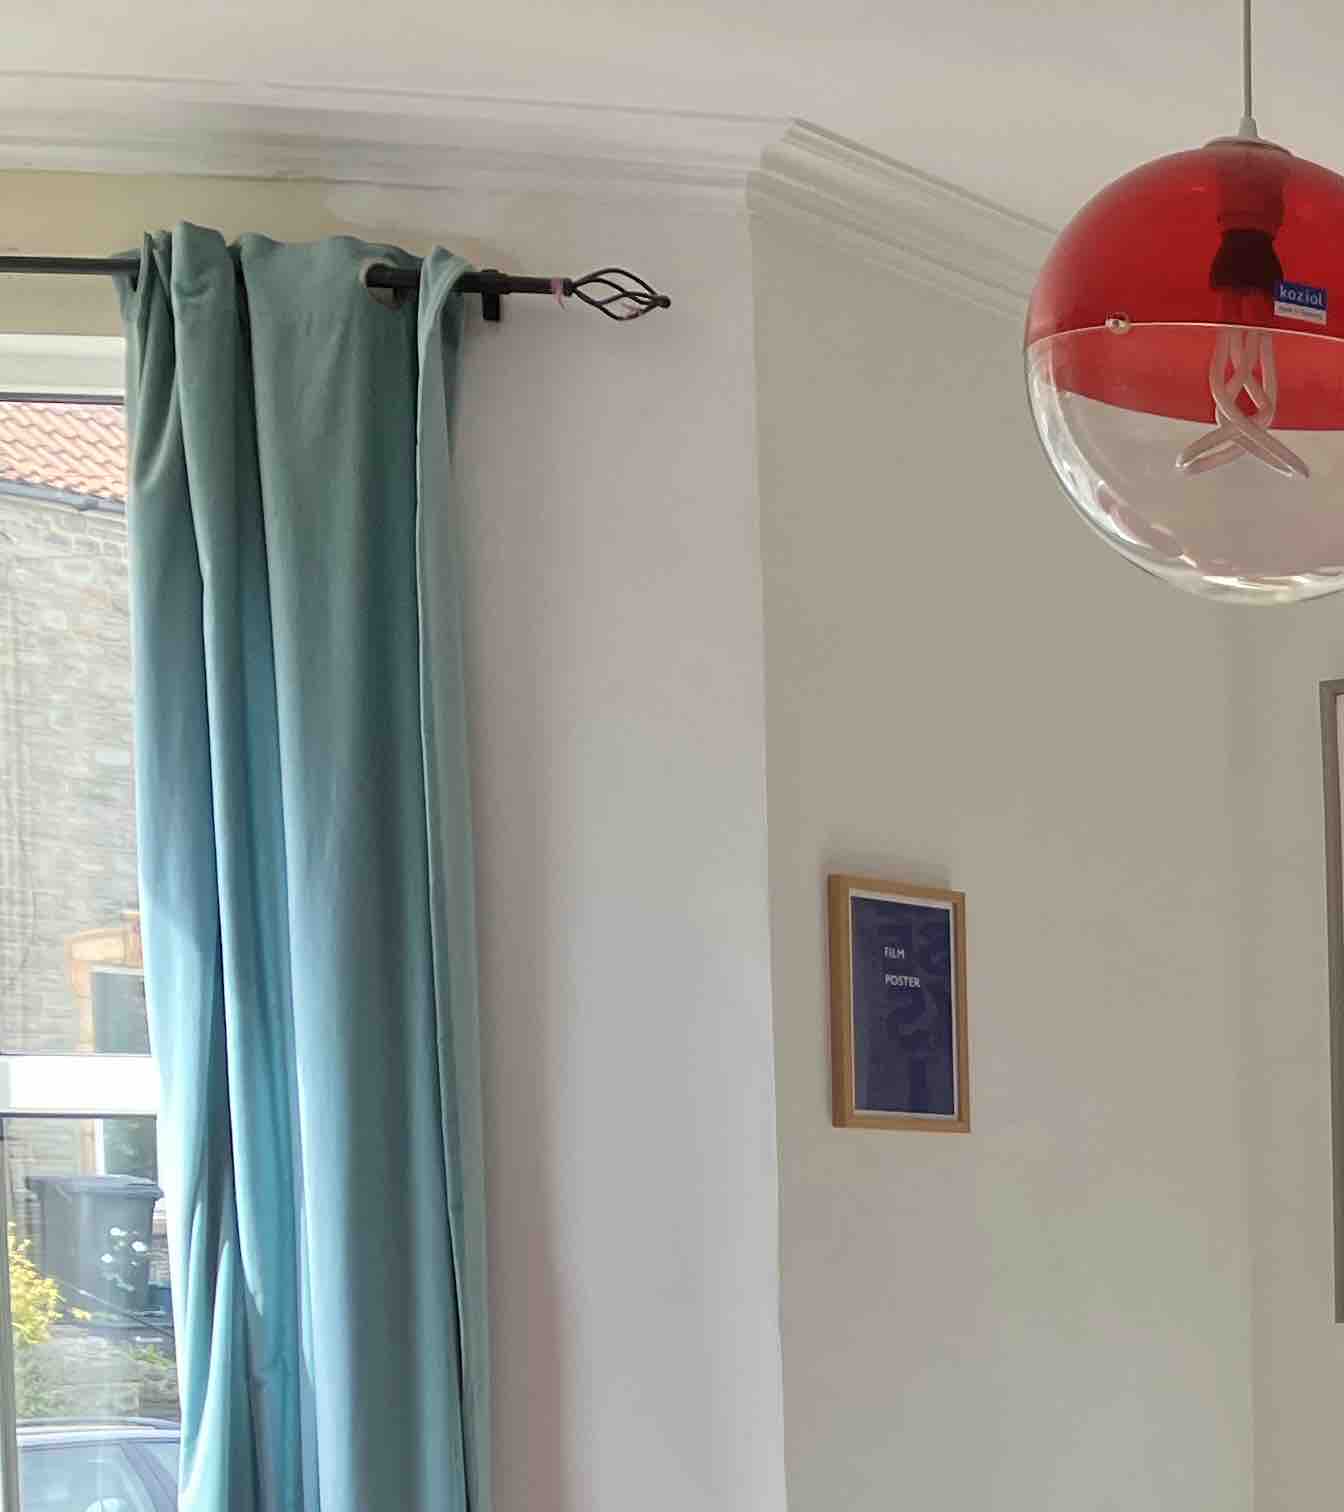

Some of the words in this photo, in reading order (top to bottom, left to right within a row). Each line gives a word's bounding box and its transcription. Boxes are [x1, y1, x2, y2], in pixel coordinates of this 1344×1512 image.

[1279, 283, 1323, 306] koziol
[884, 946, 905, 960] FILM
[885, 974, 921, 988] POSTER
